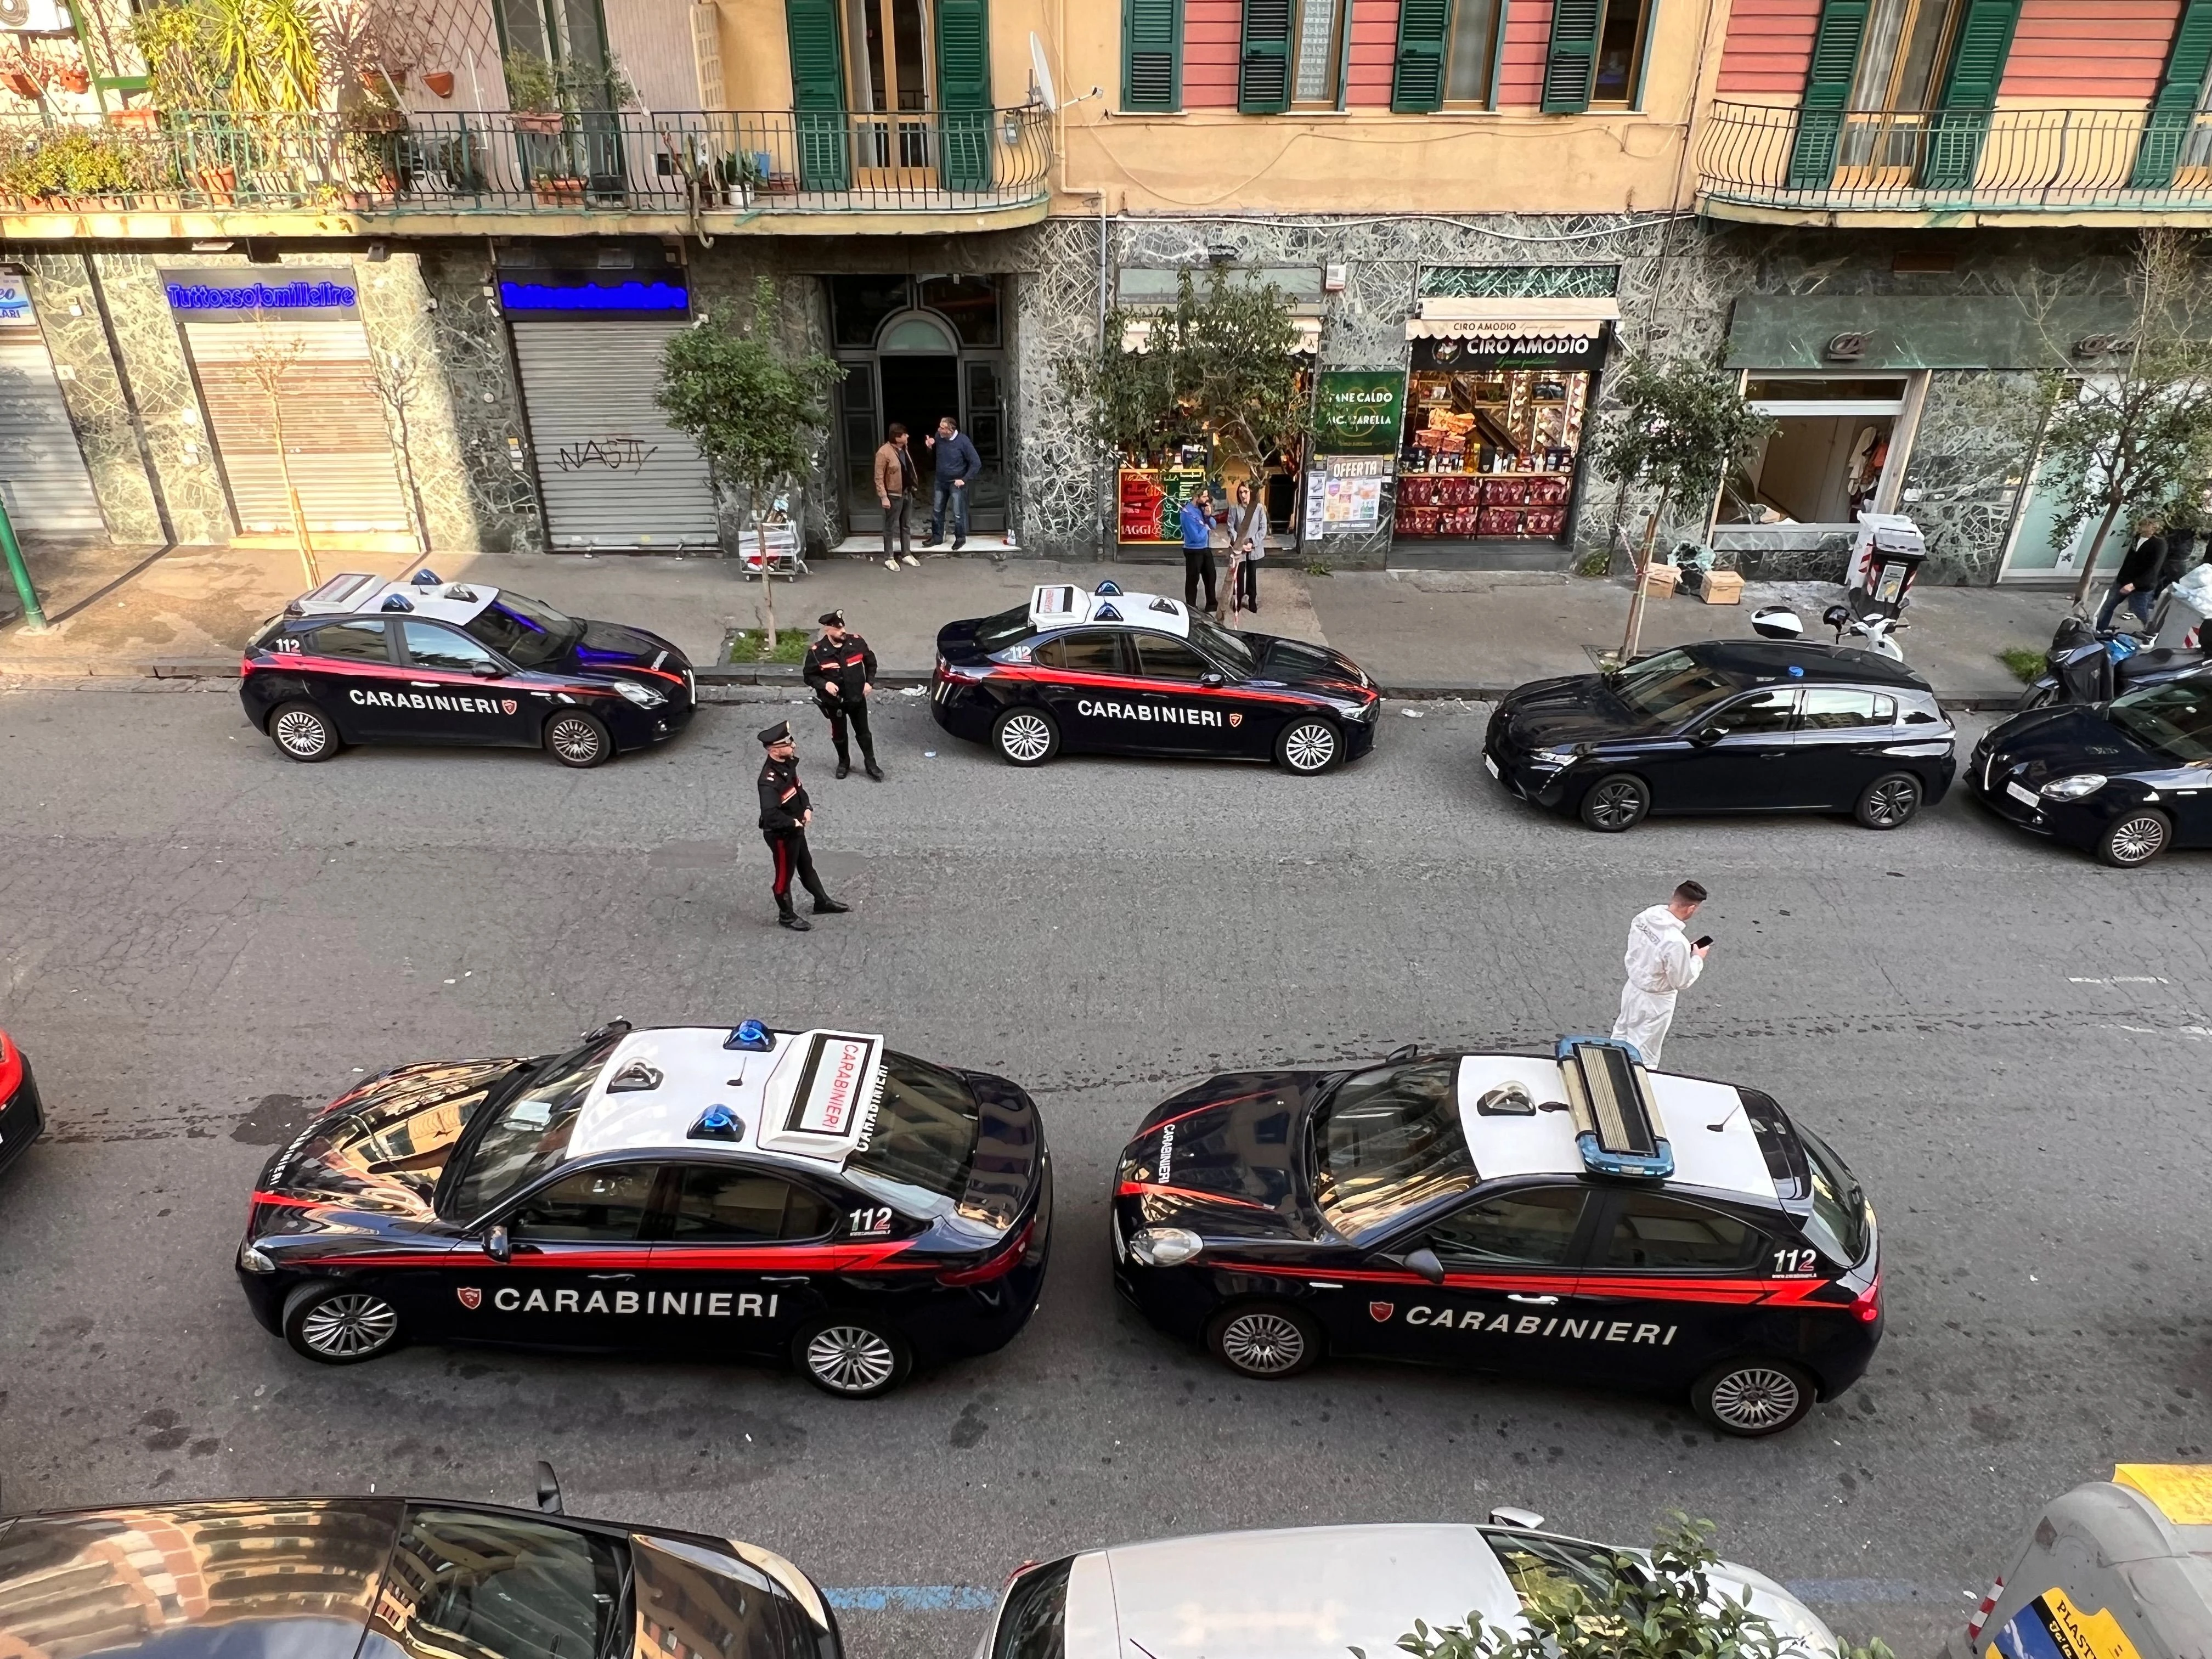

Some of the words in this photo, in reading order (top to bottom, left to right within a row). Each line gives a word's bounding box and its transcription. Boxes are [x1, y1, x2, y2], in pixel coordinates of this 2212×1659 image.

[1467, 339, 1510, 354] CIRO
[1513, 338, 1589, 354] AMODIO
[1357, 392, 1393, 403] CALDO
[1333, 461, 1377, 477] OFFERTA
[276, 638, 301, 653] 112
[1009, 645, 1031, 661] 112
[349, 690, 500, 714] CARABINIERI
[1078, 700, 1222, 727] CARABINIERI
[822, 1044, 859, 1128] CARABINIERI
[1158, 1124, 1176, 1184] CARABINIERI
[849, 1207, 892, 1231] 112
[1774, 1249, 1816, 1272] 112
[494, 1288, 778, 1317] CARABINIERI
[1406, 1304, 1678, 1346] CARABINIERI
